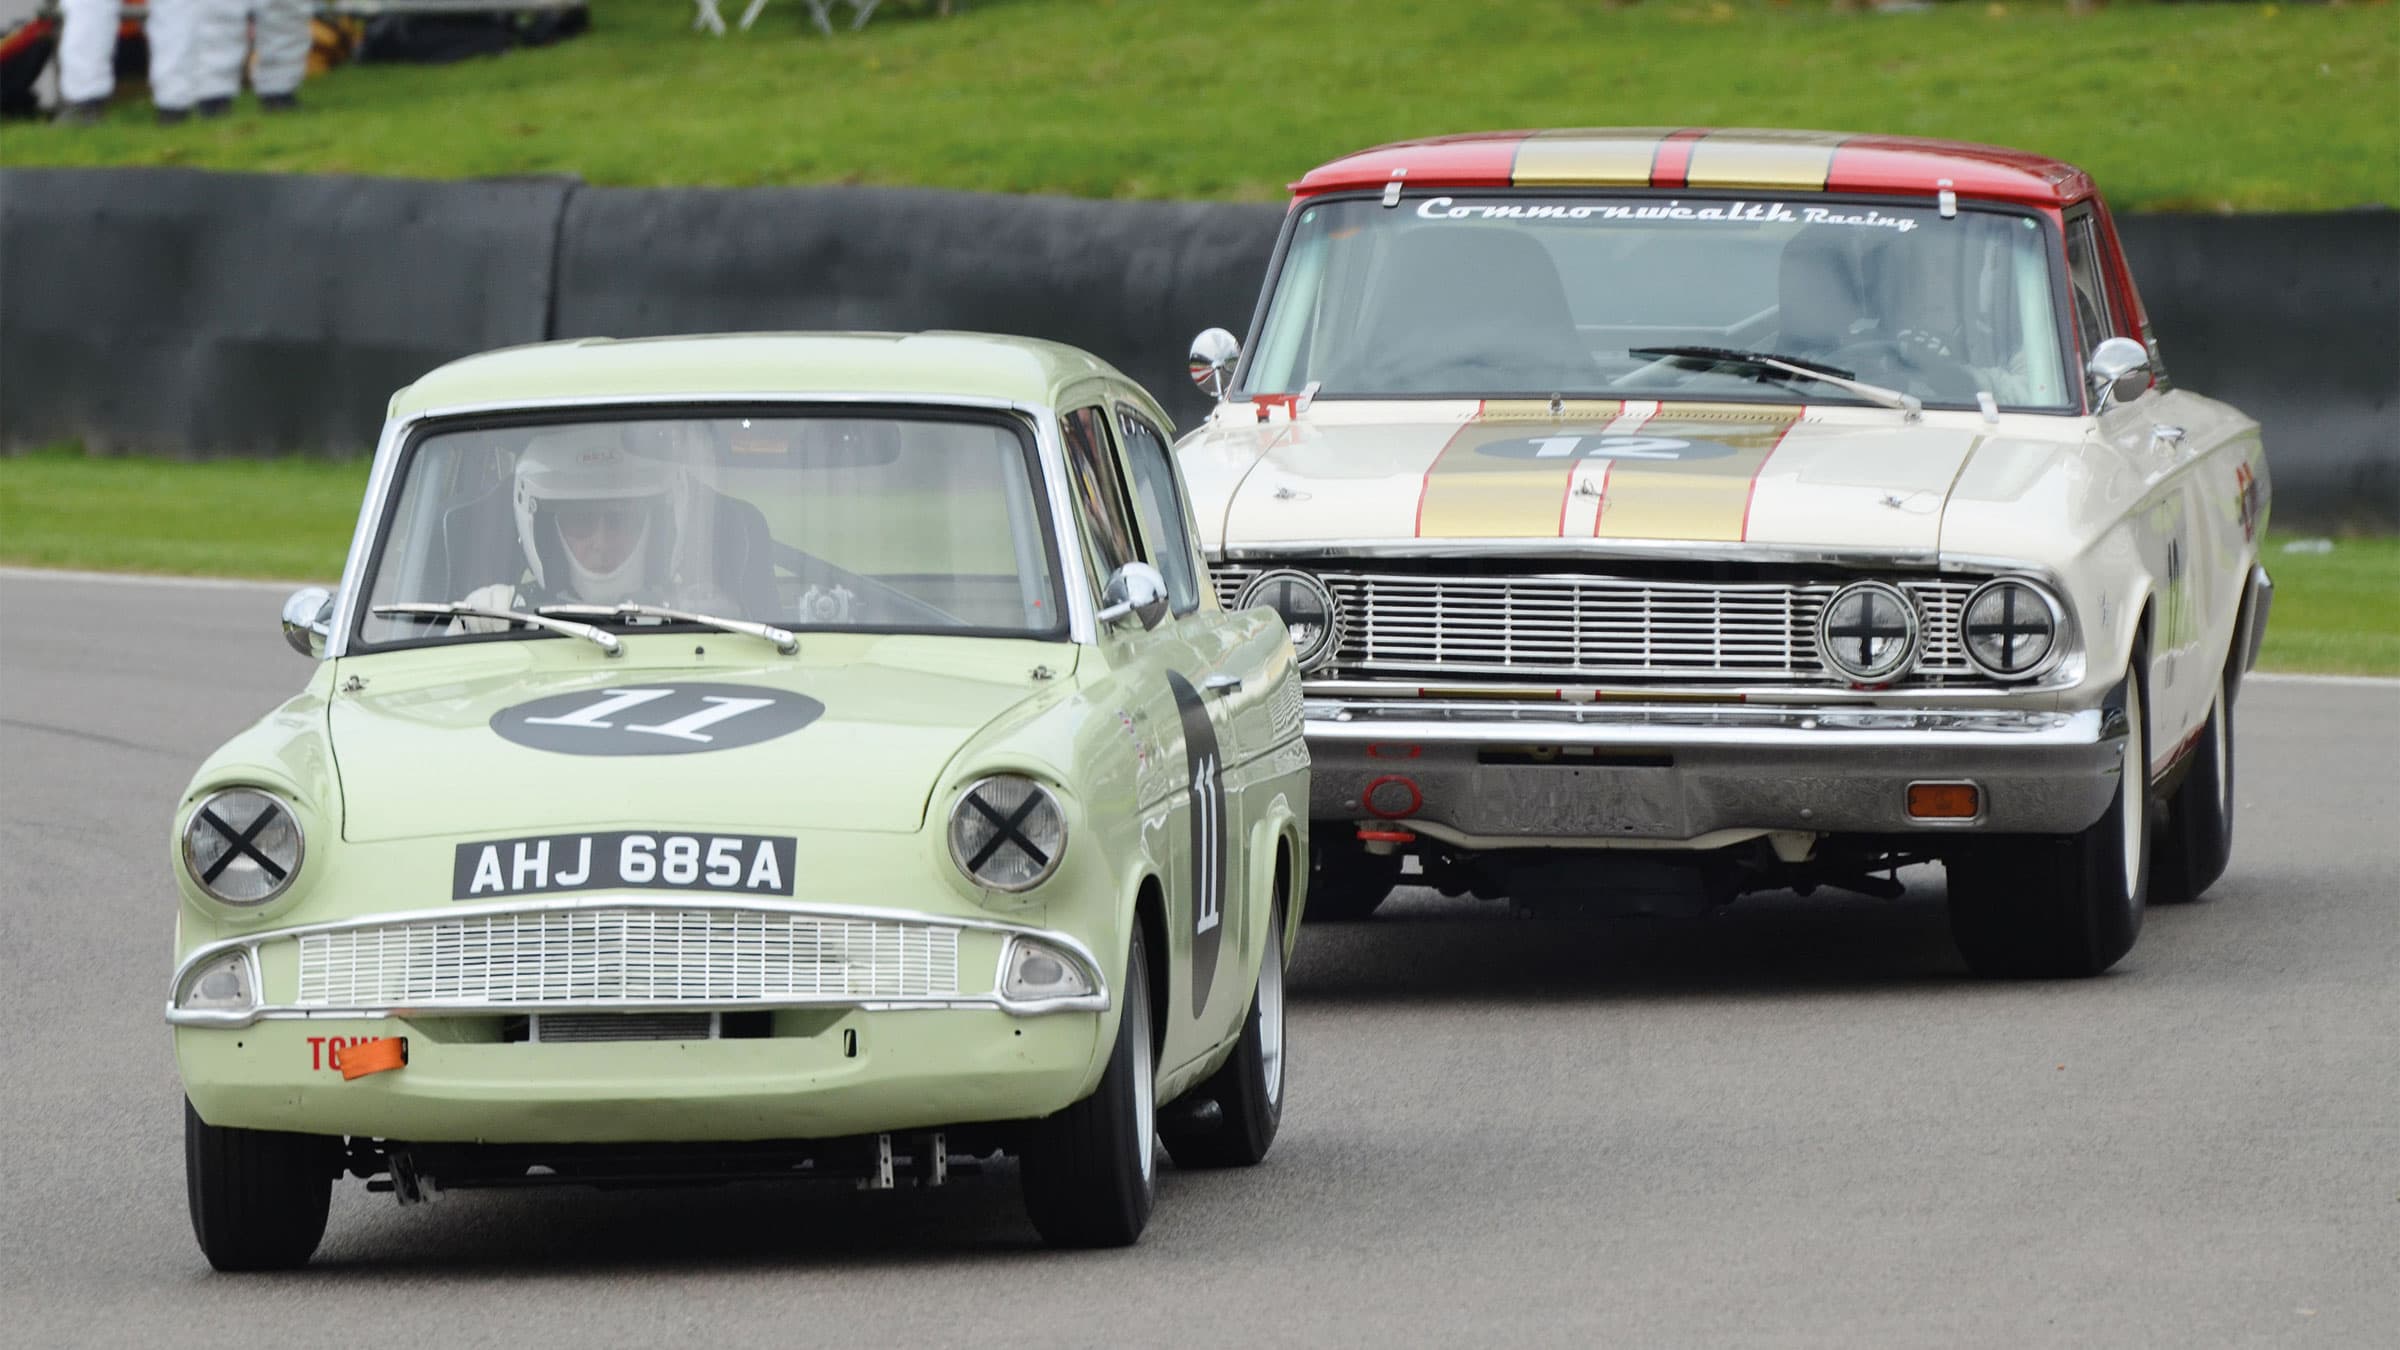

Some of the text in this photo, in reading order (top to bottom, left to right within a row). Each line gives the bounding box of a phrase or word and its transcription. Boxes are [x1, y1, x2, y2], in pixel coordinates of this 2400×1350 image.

[1416, 197, 1918, 231] Commonwealth Racing
[1528, 436, 1691, 459] 12
[524, 688, 776, 743] 11
[470, 834, 782, 894] AHJ 685A
[1195, 754, 1219, 935] 11
[307, 1036, 380, 1071] TO
